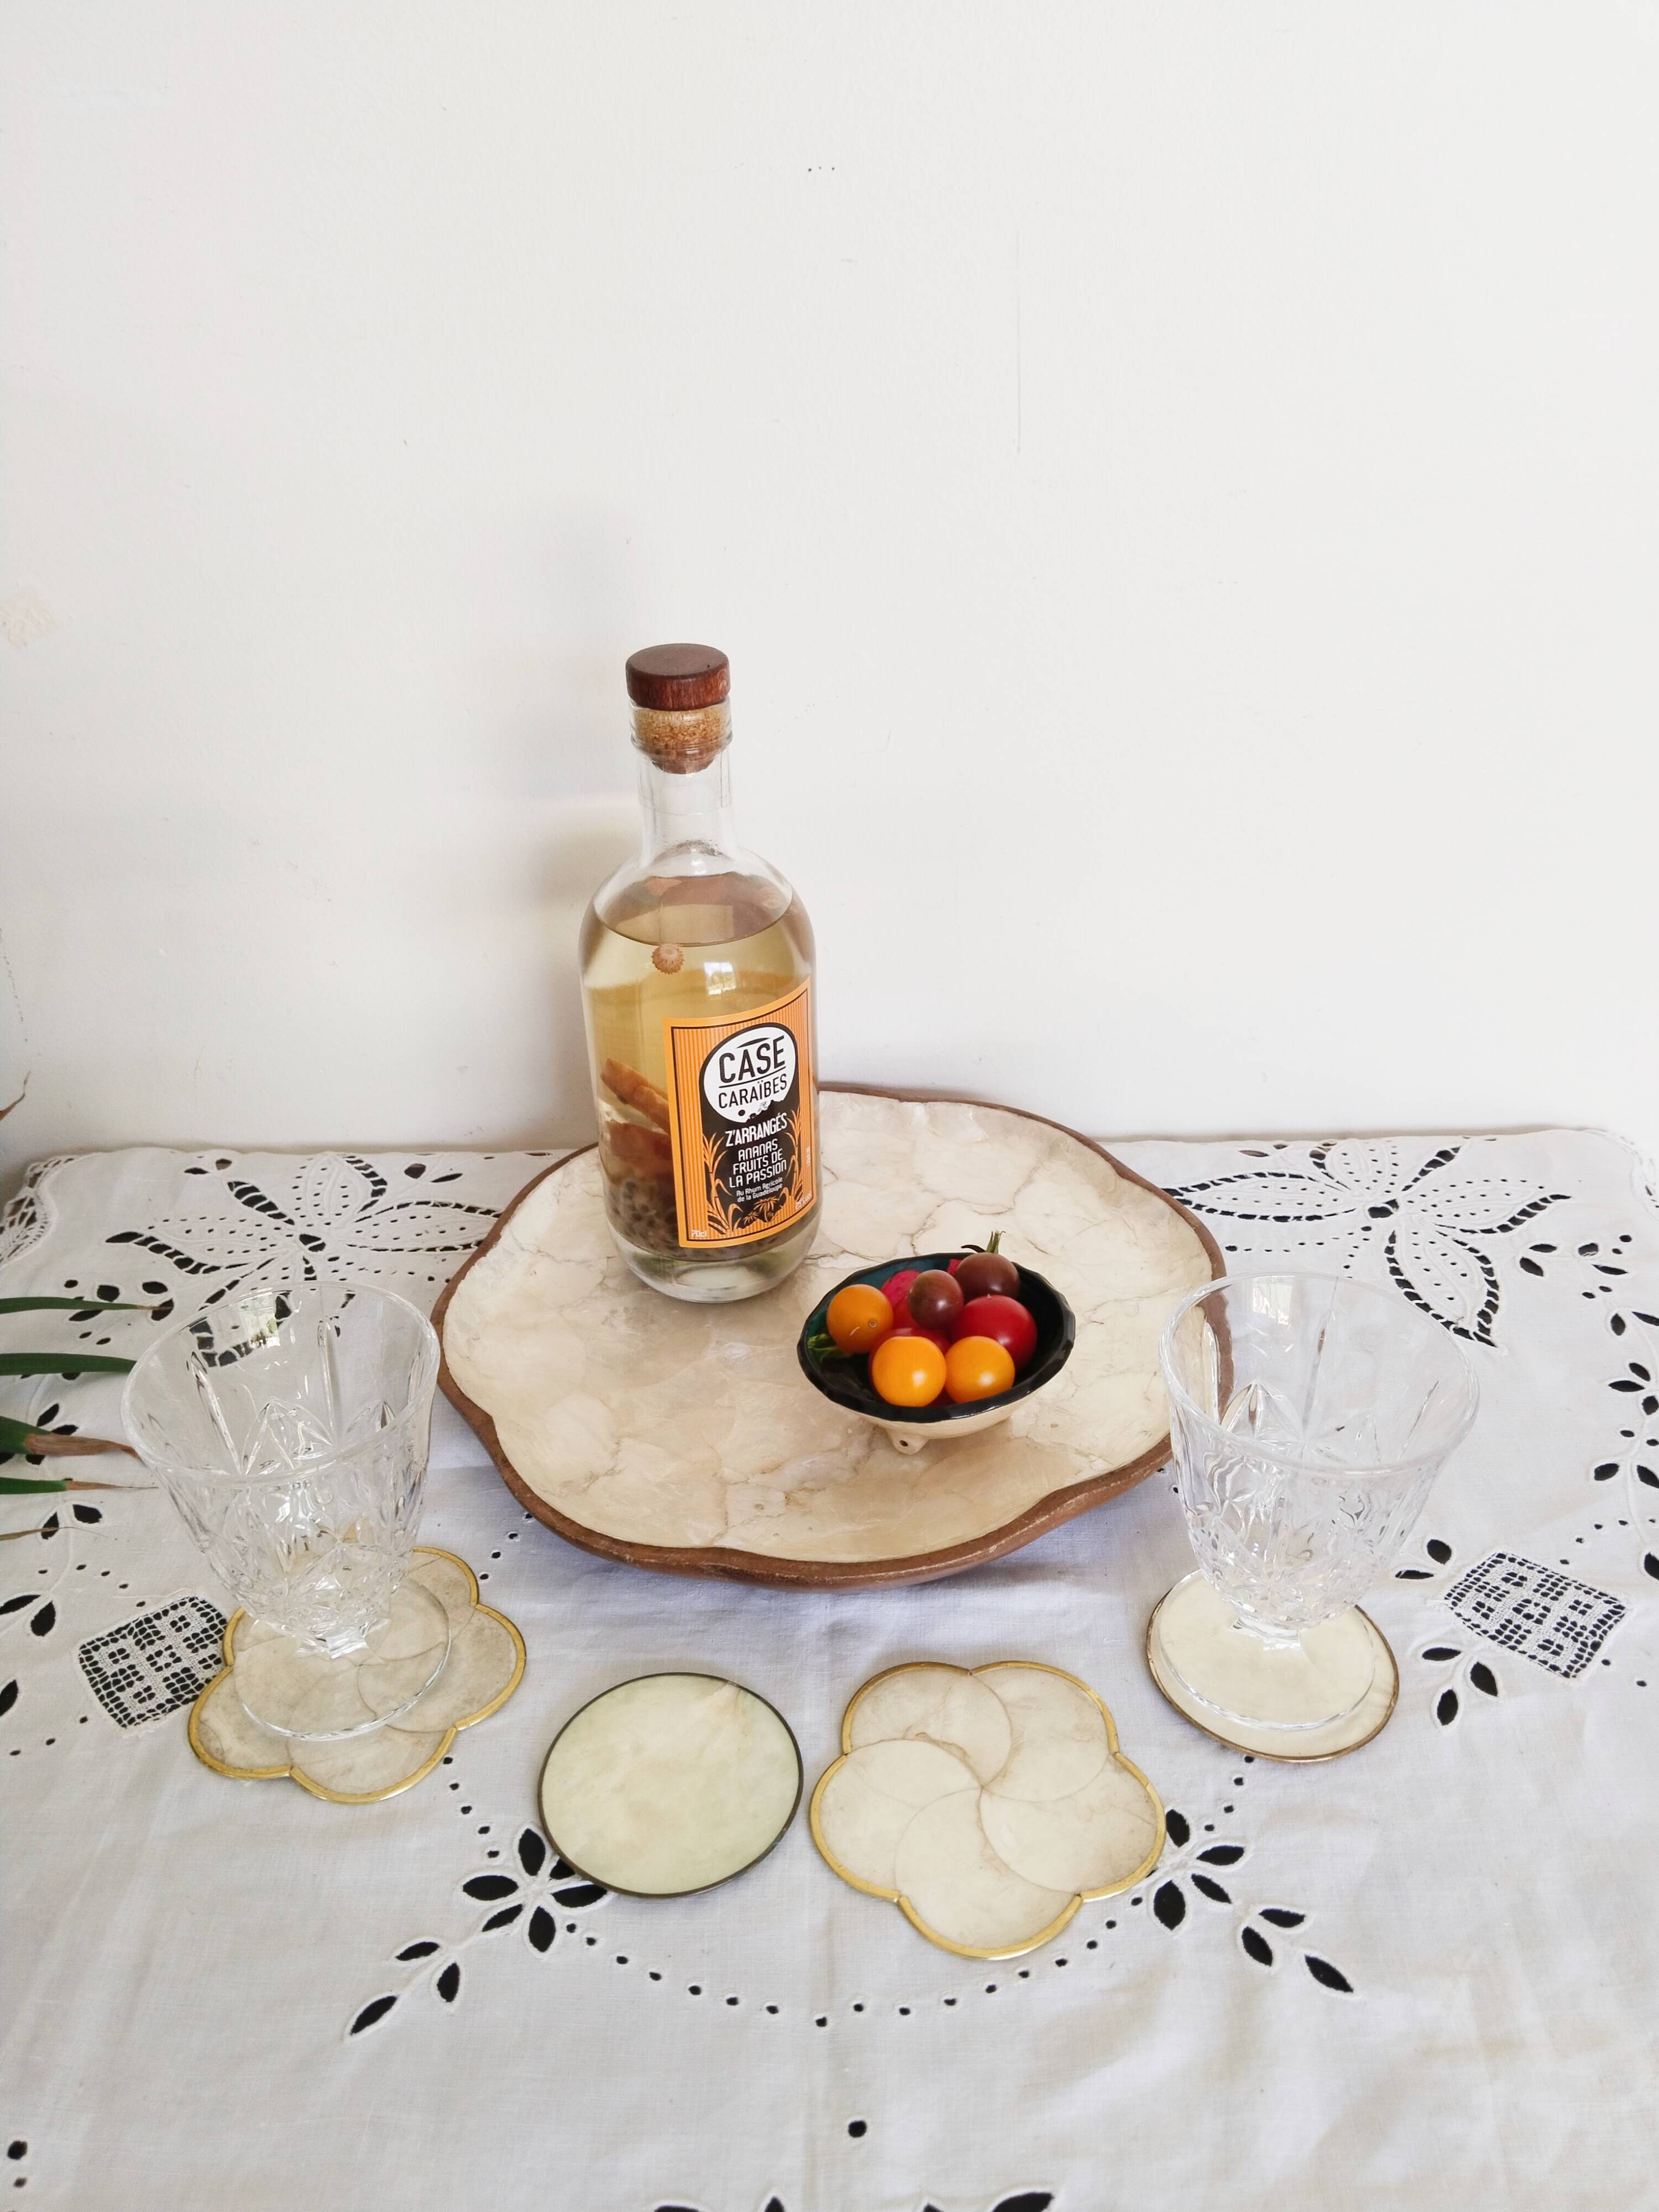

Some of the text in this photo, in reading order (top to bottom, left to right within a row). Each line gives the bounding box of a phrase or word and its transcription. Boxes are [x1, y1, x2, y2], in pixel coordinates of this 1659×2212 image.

[719, 1035, 785, 1083] CASE
[718, 1073, 787, 1109] CARAÏBES
[725, 1112, 787, 1147] Z'ARRANGÉS
[733, 1148, 783, 1175] FRUITS DE
[738, 1138, 778, 1161] ANANAS
[729, 1159, 787, 1188] LA PASSION
[745, 1186, 761, 1194] Rhum
[762, 1177, 783, 1190] Agricole
[753, 1183, 783, 1199] Guadeloupe
